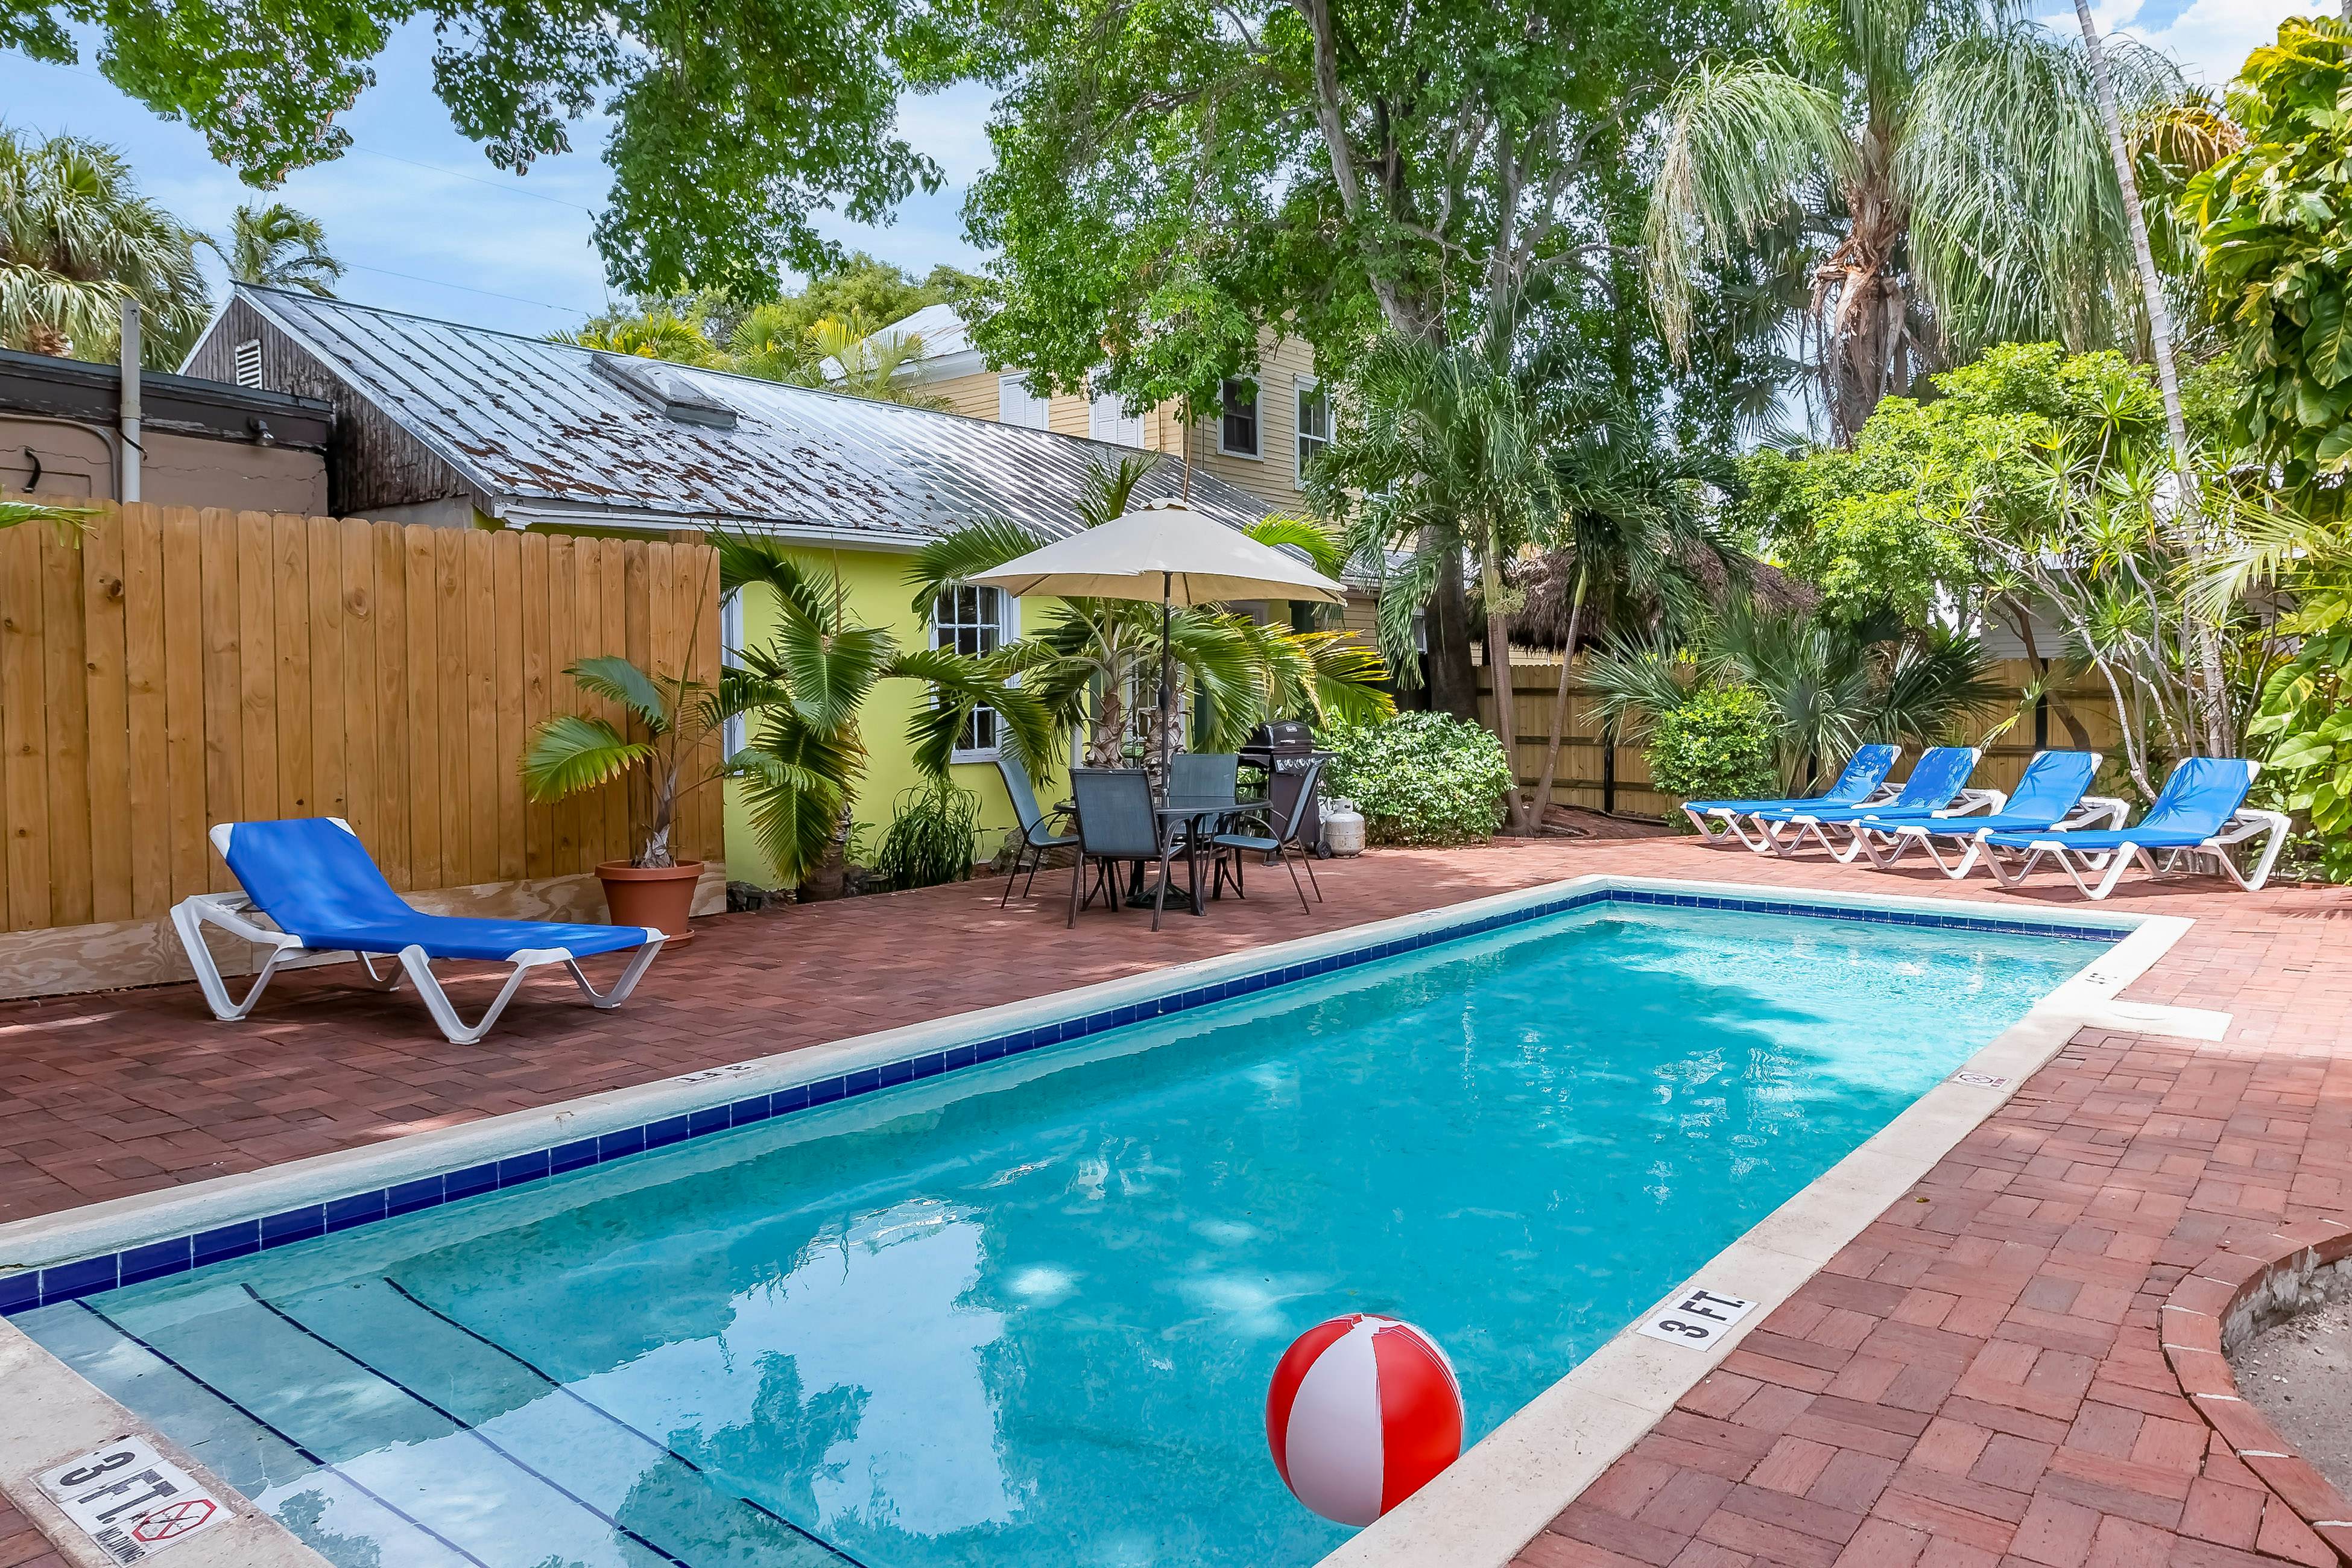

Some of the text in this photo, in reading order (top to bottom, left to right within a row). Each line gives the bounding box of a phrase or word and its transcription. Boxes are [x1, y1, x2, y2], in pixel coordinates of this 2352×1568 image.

[1659, 1291, 1745, 1338] 3 FT.
[60, 1452, 180, 1525] 3 FT.
[96, 1526, 146, 1563] NO DIVING
